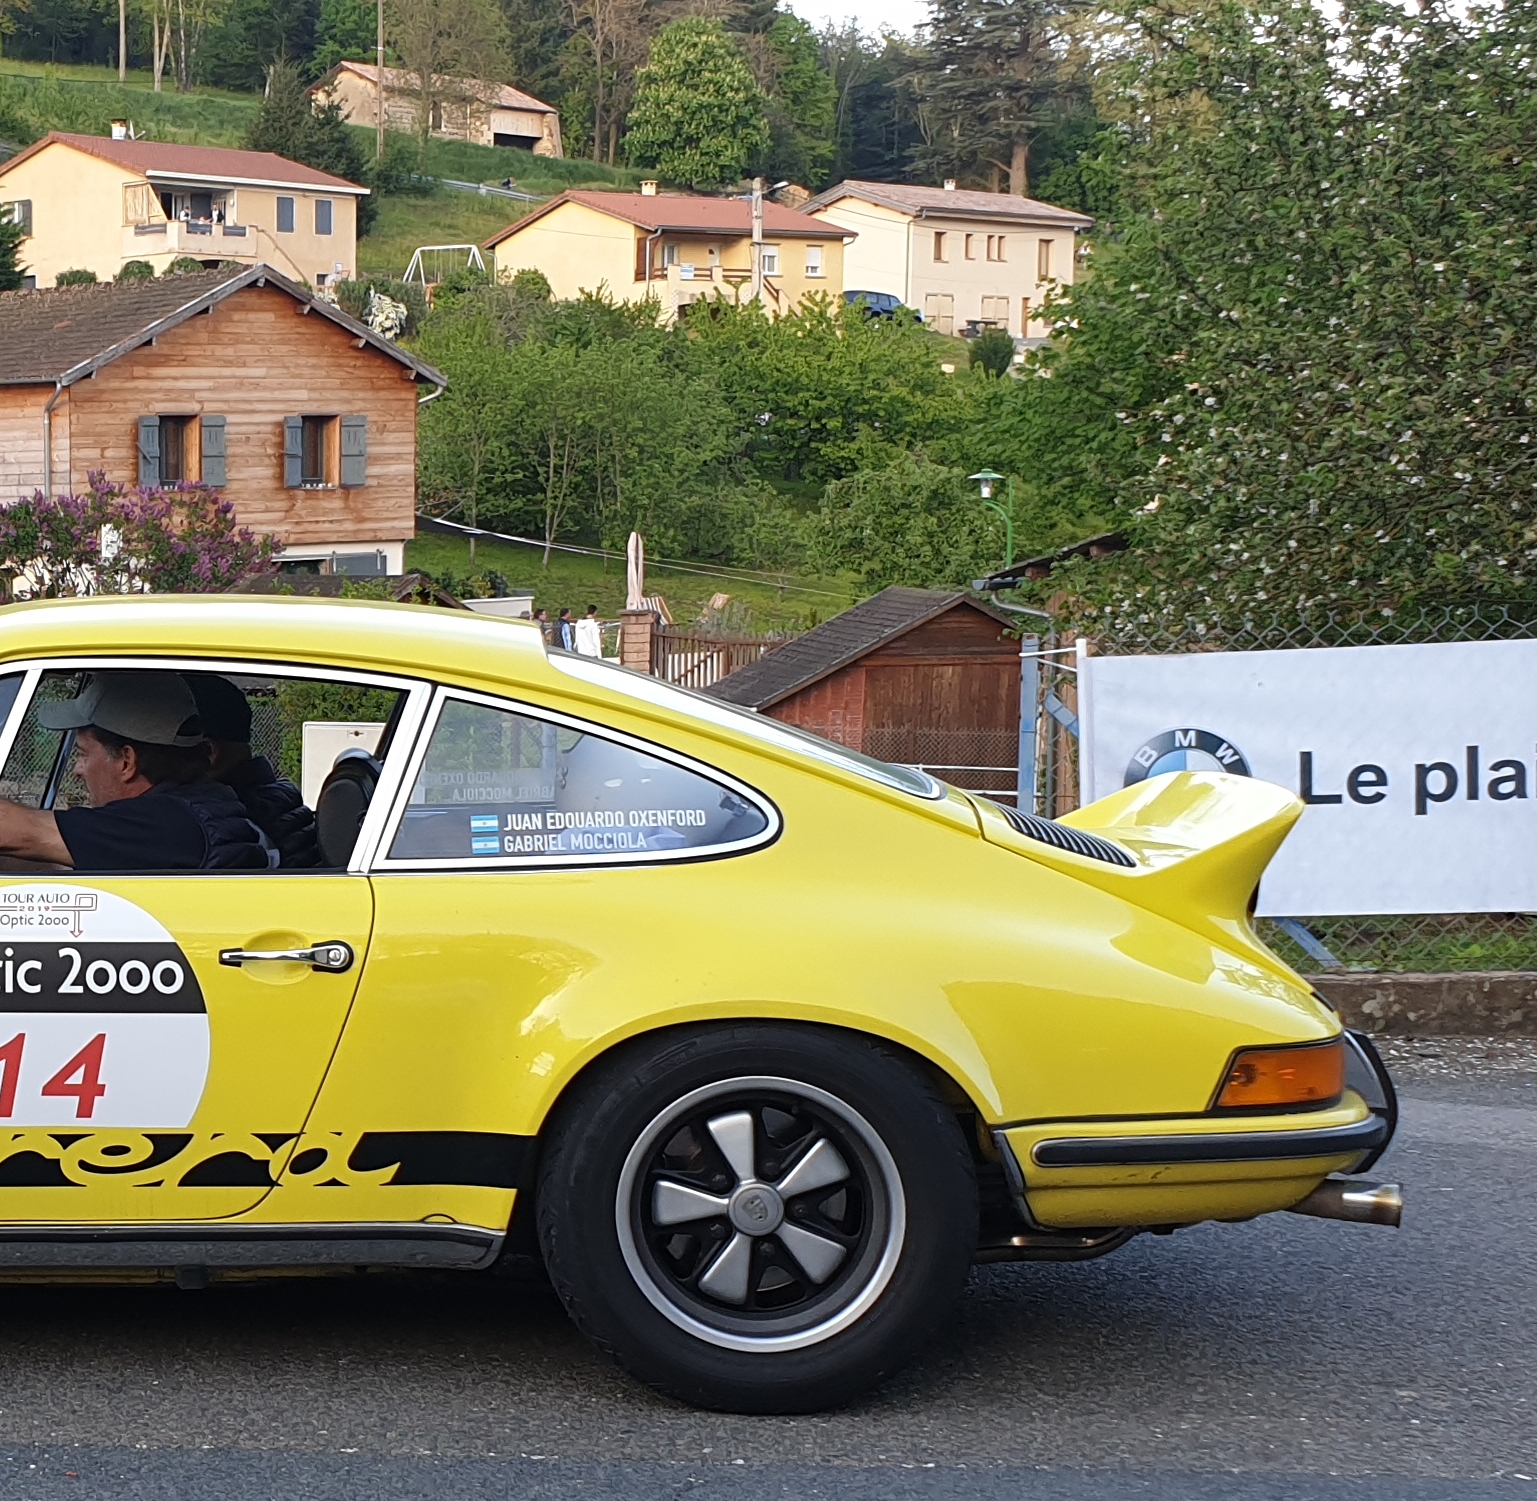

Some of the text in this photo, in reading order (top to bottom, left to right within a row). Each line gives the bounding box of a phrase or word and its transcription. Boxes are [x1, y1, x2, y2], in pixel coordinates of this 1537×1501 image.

[1133, 729, 1240, 768] BMW
[1299, 743, 1537, 815] Le pla
[504, 809, 706, 831] JUAN EDOUARDO OXENFORD
[504, 832, 647, 853] GABRIEL MOCCIOLA
[3, 893, 70, 903] TOUR AUTO
[0, 914, 69, 928] Optic 2000
[58, 948, 184, 994] 2000
